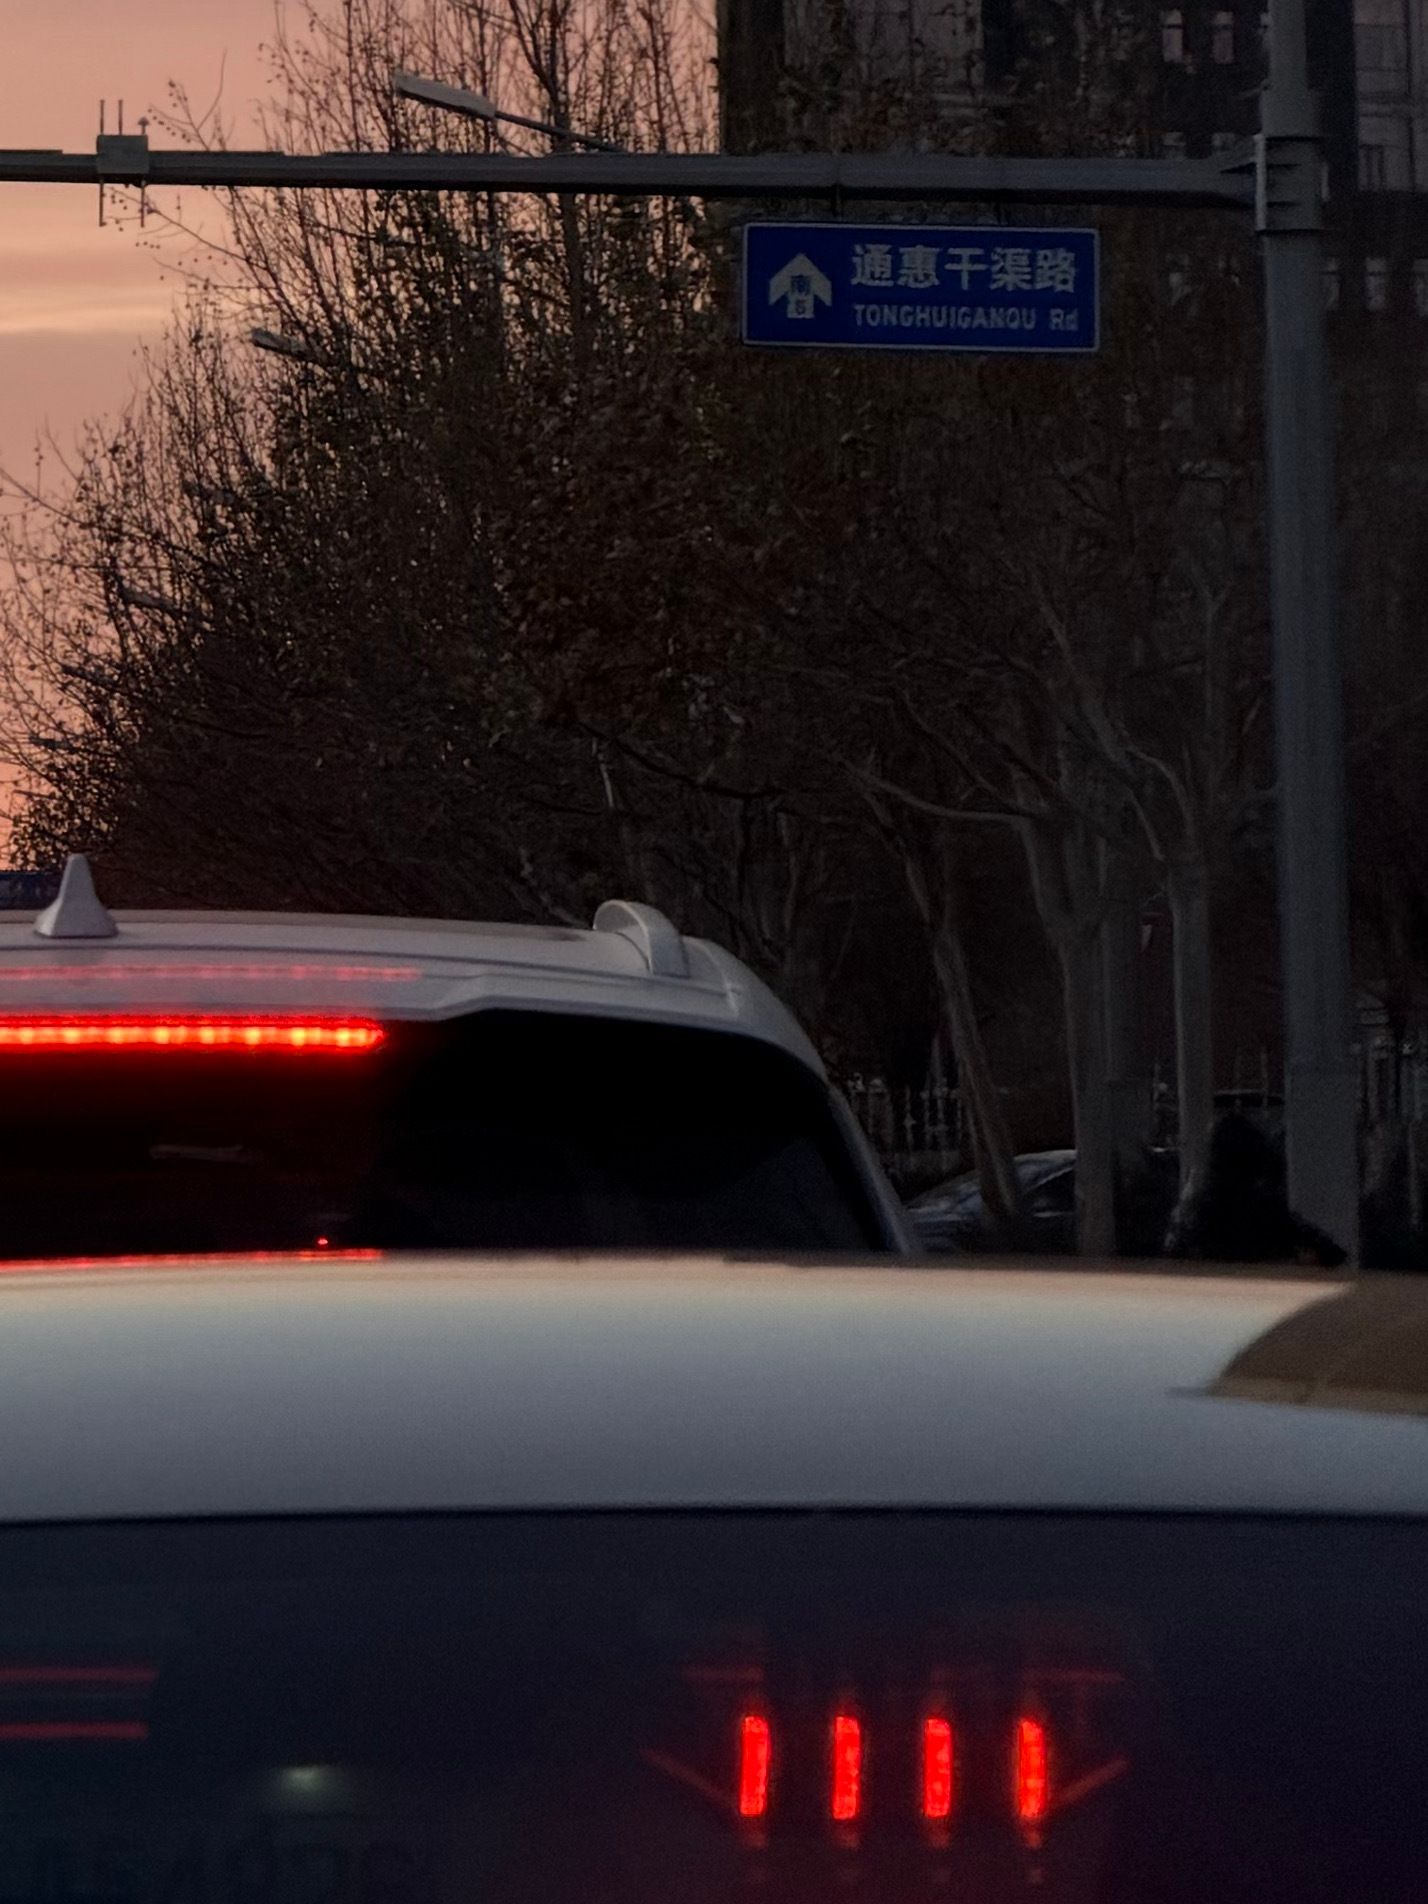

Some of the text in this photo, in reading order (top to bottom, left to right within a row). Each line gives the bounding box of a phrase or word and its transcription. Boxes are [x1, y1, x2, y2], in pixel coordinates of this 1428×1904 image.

[851, 243, 1079, 294] 通惠干渠路
[1048, 307, 1080, 332] Rd
